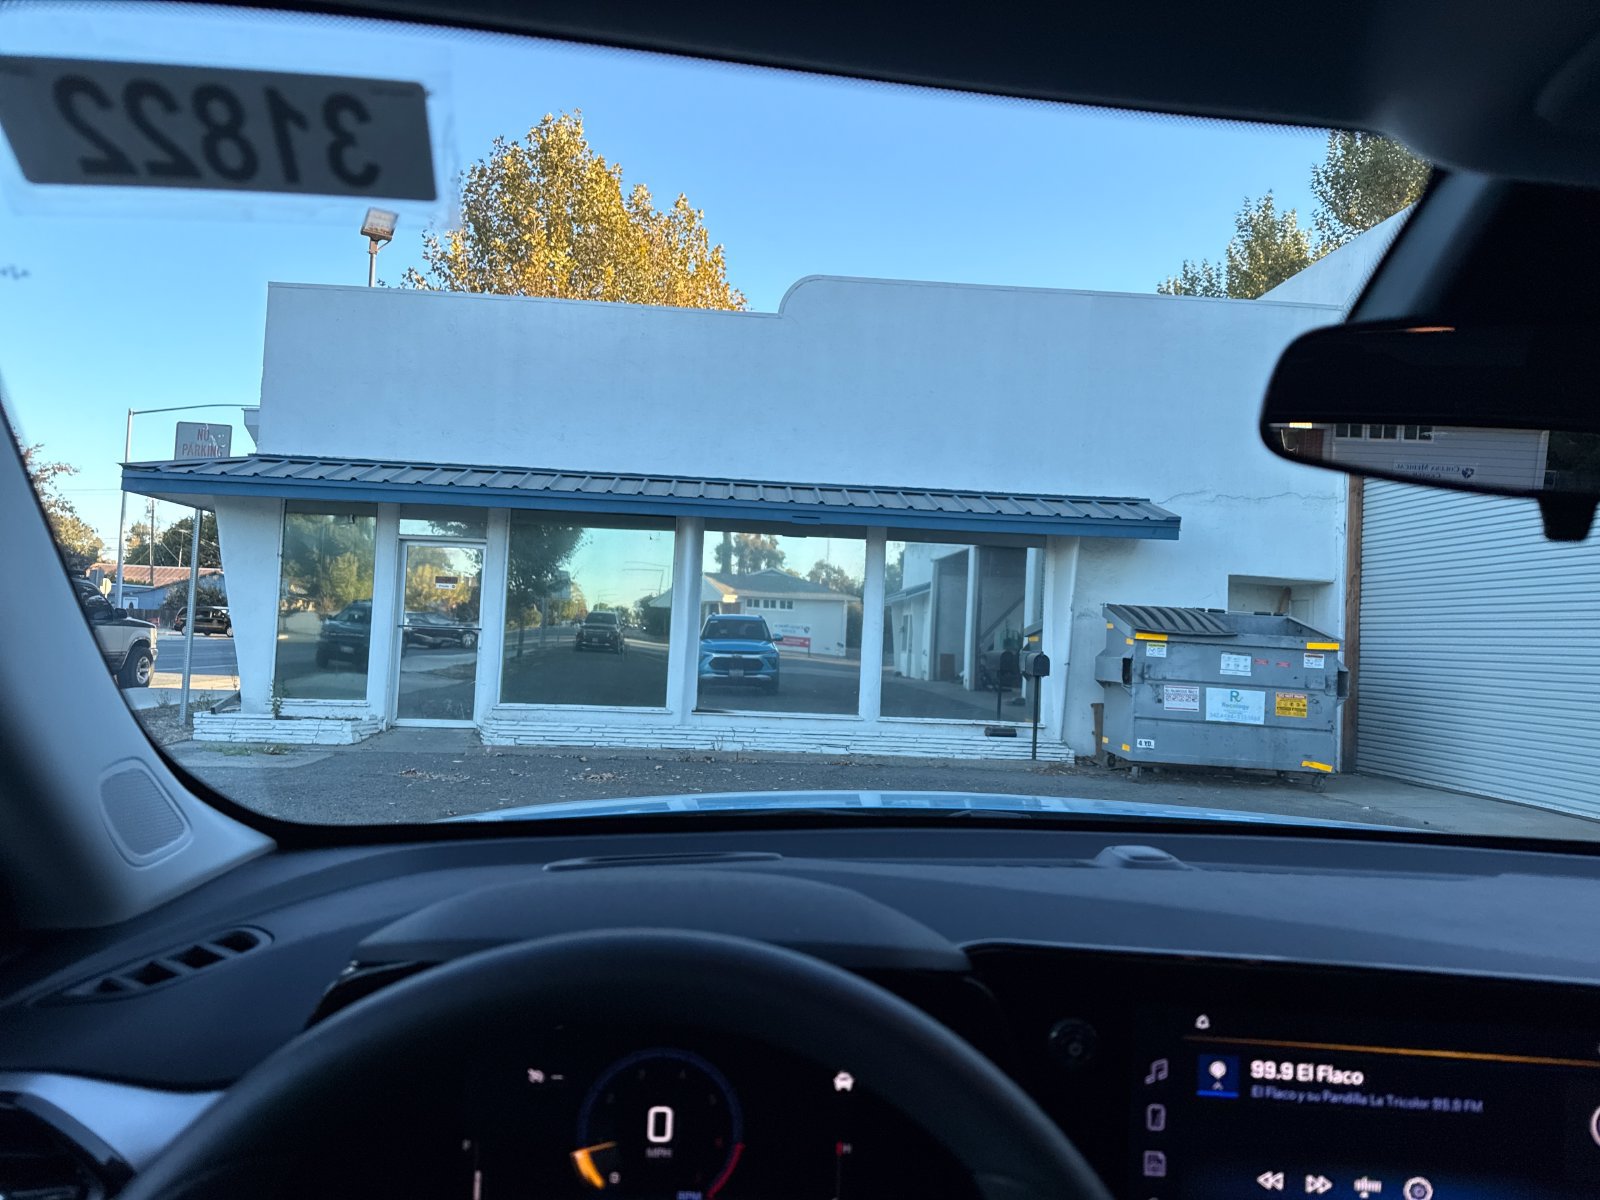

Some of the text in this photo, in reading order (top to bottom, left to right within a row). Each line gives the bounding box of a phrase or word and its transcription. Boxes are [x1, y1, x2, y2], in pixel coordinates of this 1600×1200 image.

[196, 428, 210, 441] NO
[182, 443, 223, 457] PARKING
[1250, 1059, 1294, 1080] 99.9
[1316, 1064, 1365, 1085] Flaco
[646, 1105, 675, 1143] 0
